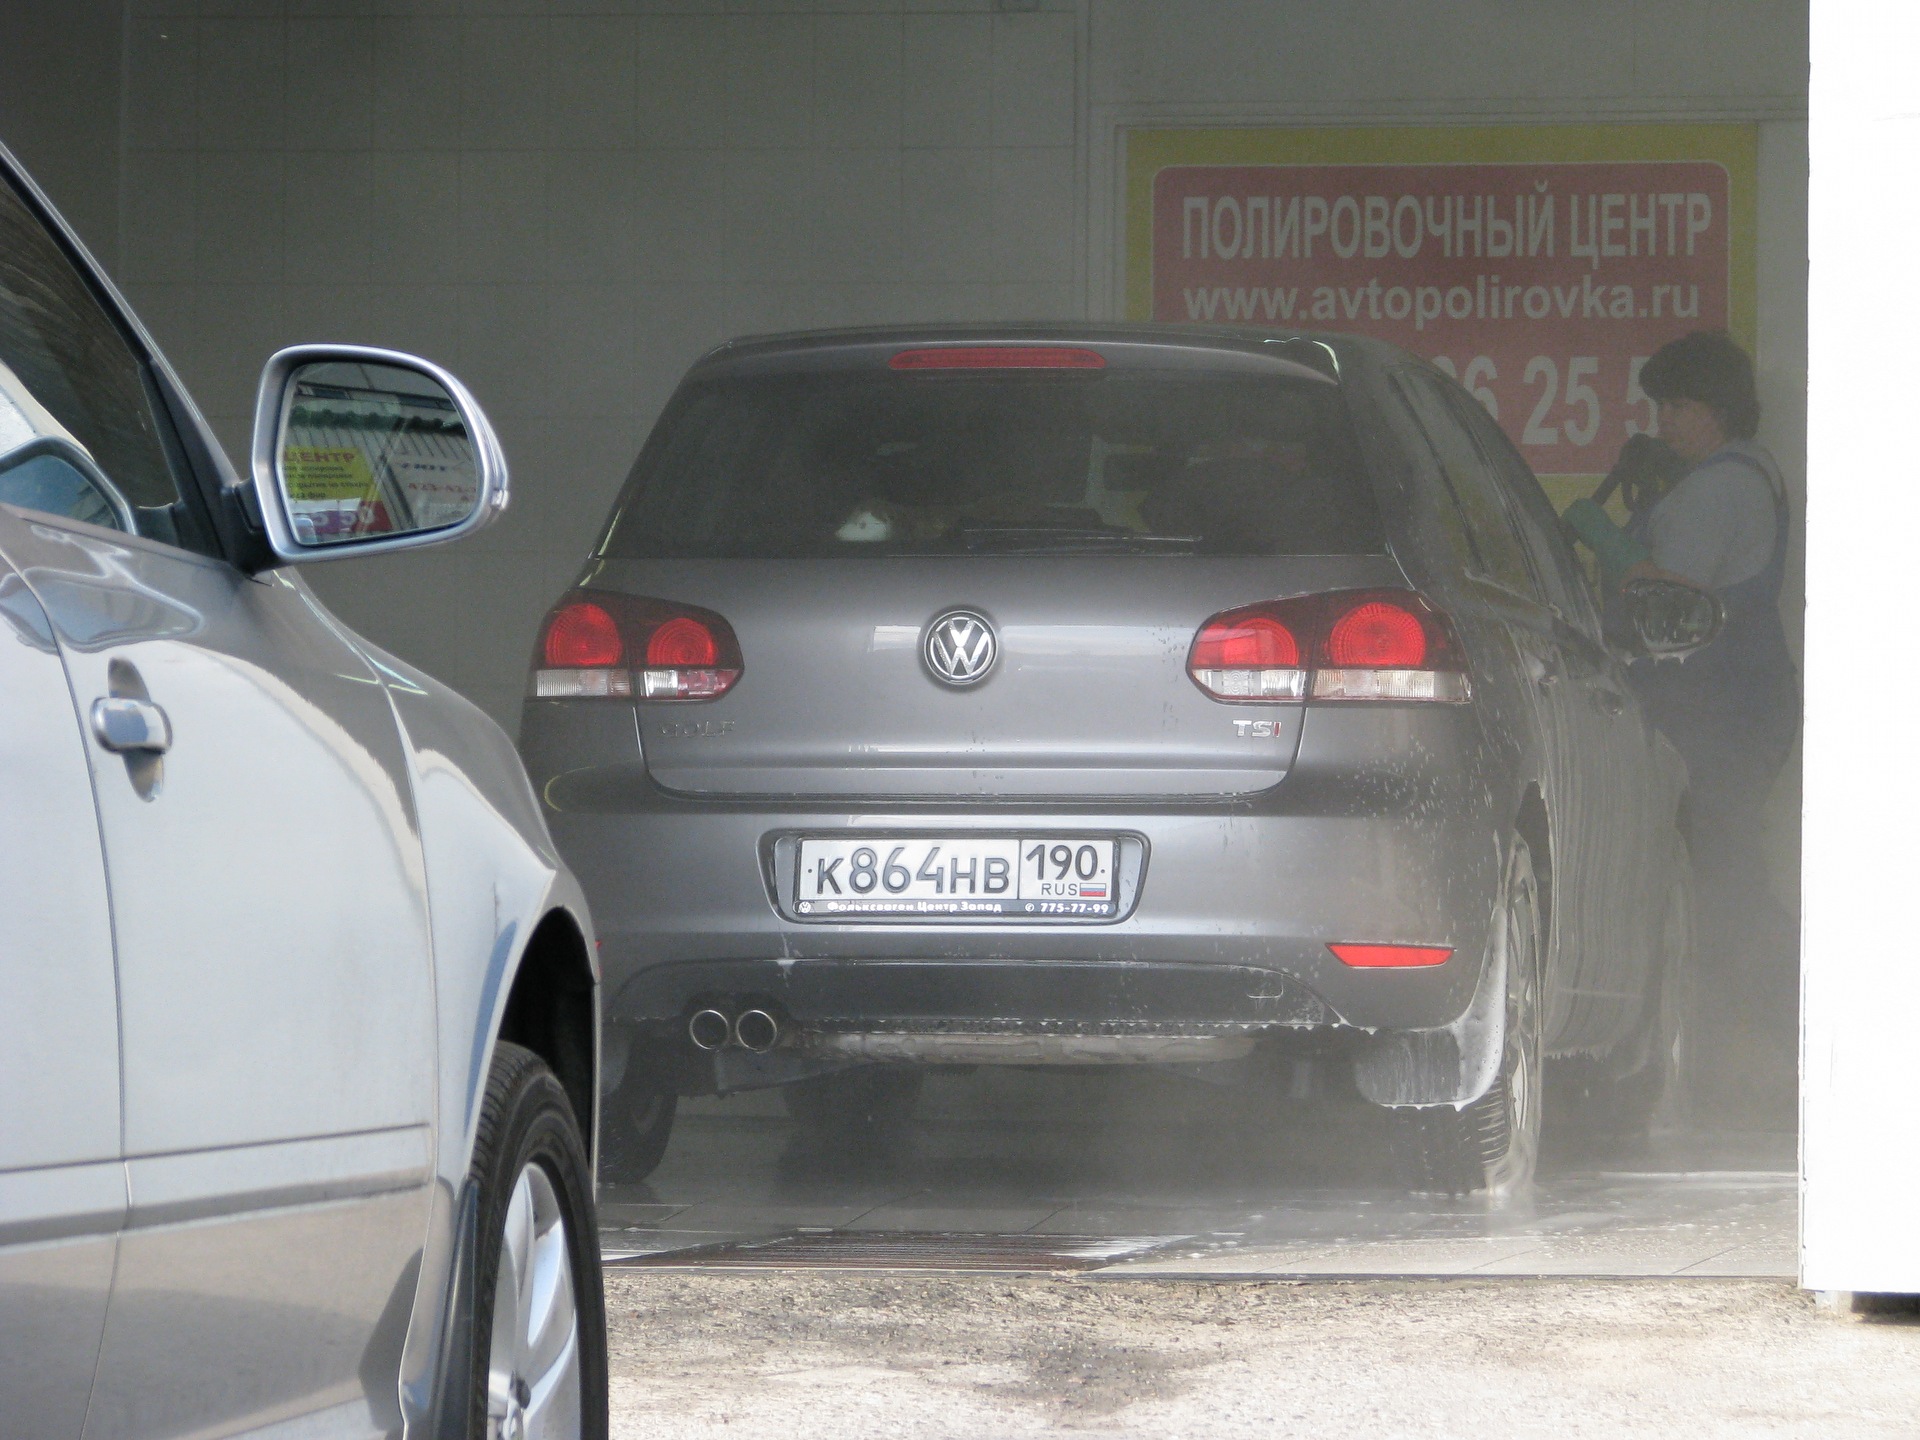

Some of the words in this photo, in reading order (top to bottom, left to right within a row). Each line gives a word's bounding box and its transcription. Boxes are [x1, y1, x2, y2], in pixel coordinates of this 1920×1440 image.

[1182, 180, 1556, 260] ПОЛИРОВОЧНЫЙ
[1570, 192, 1713, 270] ЦЕНТР
[1182, 274, 1700, 331] www.avtopolirovka.ru
[1521, 354, 1600, 447] 25
[657, 719, 736, 738] GOLF
[1232, 719, 1283, 738] TSI
[816, 846, 1011, 895] К864НВ
[1025, 843, 1099, 881] 190
[1041, 882, 1078, 896] RUS
[827, 901, 914, 912] Фольксваген
[917, 901, 957, 913] Центр
[960, 901, 1002, 913] Запад
[1040, 902, 1109, 913] 775-77-99
